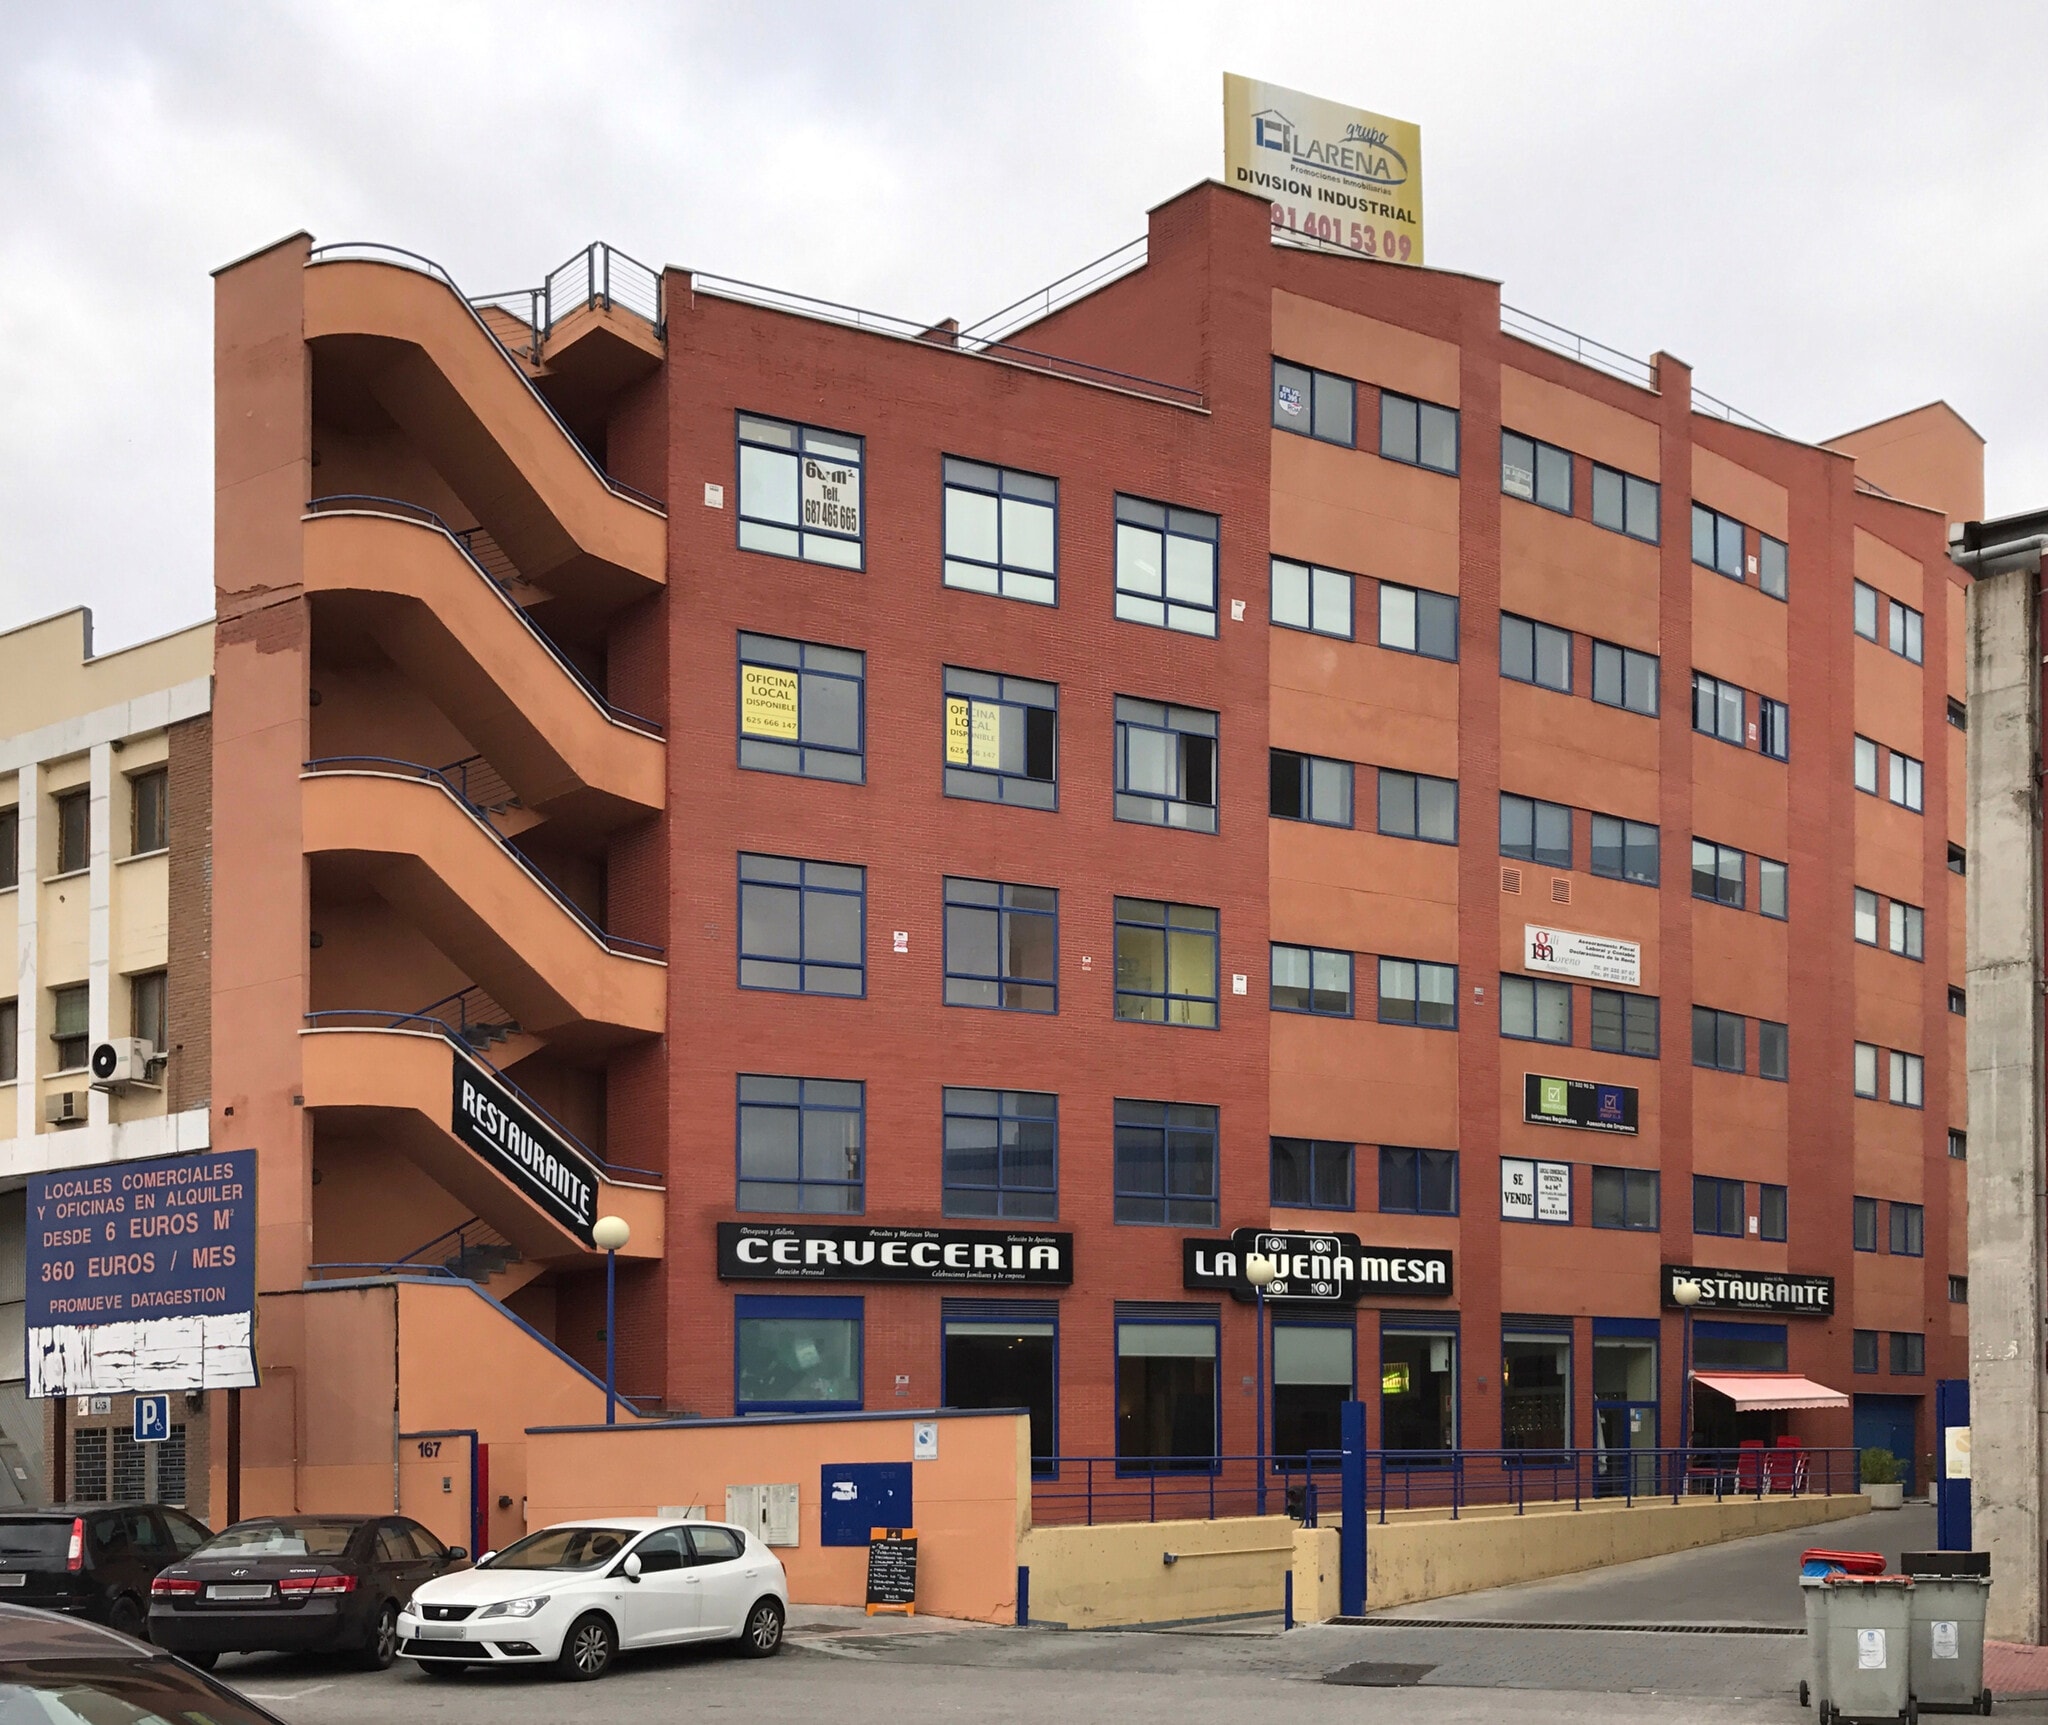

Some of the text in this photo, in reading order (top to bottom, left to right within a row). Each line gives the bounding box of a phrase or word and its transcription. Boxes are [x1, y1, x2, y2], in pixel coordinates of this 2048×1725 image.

[1346, 122, 1389, 148] grupo
[1291, 164, 1391, 195] Promociones Inmobiliarias
[1237, 167, 1416, 224] DIVISION INDUSTRIAL
[1272, 203, 1411, 261] 91 401 53 09
[805, 499, 857, 532] 687 465 665
[746, 673, 796, 690] OFICINA
[751, 686, 792, 701] LOCAL
[746, 698, 797, 713] DISPONIBLE
[746, 716, 797, 730] 625 666 147
[950, 728, 996, 743] DISPNIBLE
[1569, 949, 1605, 958] Declaraciones
[1552, 1116, 1577, 1124] Registrales
[462, 1079, 591, 1216] RESTAURANTE
[45, 1162, 234, 1200] LOCALES COMERCIALES
[1513, 1174, 1523, 1185] SE
[37, 1184, 243, 1220] Y OFICINAS EN ALQUILER
[1504, 1192, 1532, 1205] VENDE
[43, 1228, 91, 1248] DESDE
[105, 1222, 116, 1242] 6
[129, 1212, 199, 1239] EUROS
[41, 1261, 75, 1282] 360
[88, 1252, 155, 1278] EUROS
[193, 1245, 236, 1269] MES
[801, 1268, 825, 1276] Personal
[1196, 1250, 1446, 1283] LA UENA MESA
[49, 1287, 226, 1314] PROMUEVE DATAGESTION
[142, 1399, 157, 1435] P
[417, 1441, 442, 1458] 167
